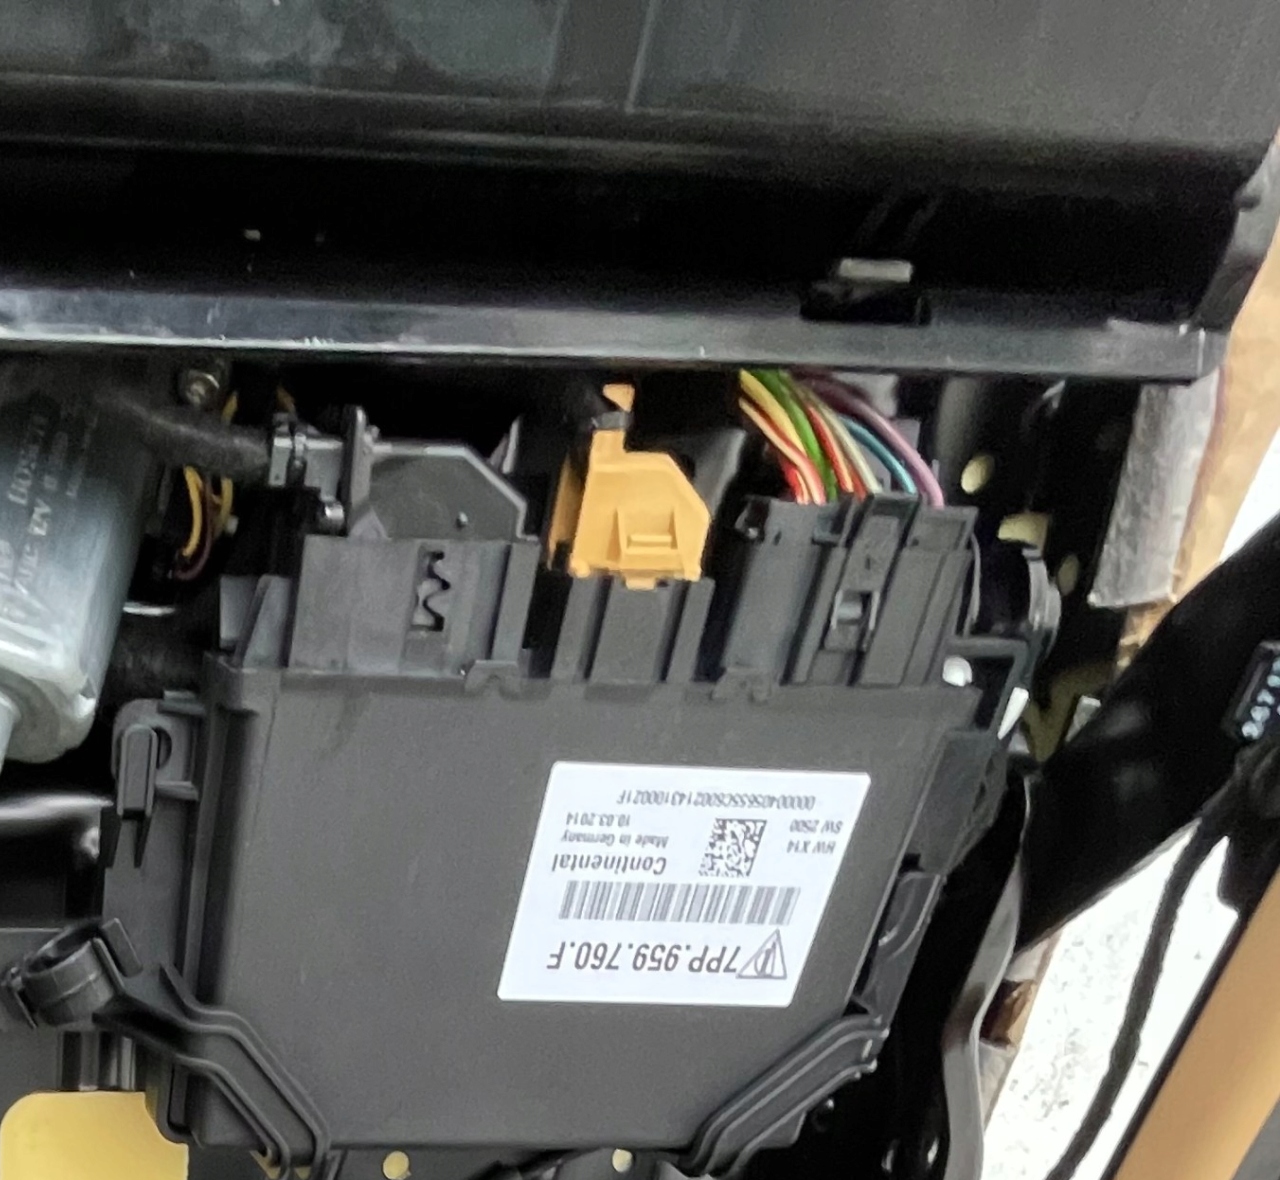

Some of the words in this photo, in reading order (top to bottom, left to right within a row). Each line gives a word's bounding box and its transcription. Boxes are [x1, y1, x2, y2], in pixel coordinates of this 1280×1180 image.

[567, 812, 630, 827] 10.03.2014
[561, 830, 614, 847] Germany
[619, 833, 631, 848] in
[635, 833, 668, 849] Made
[552, 853, 667, 875] Continental
[546, 941, 741, 973] 7PP.959.760.F
